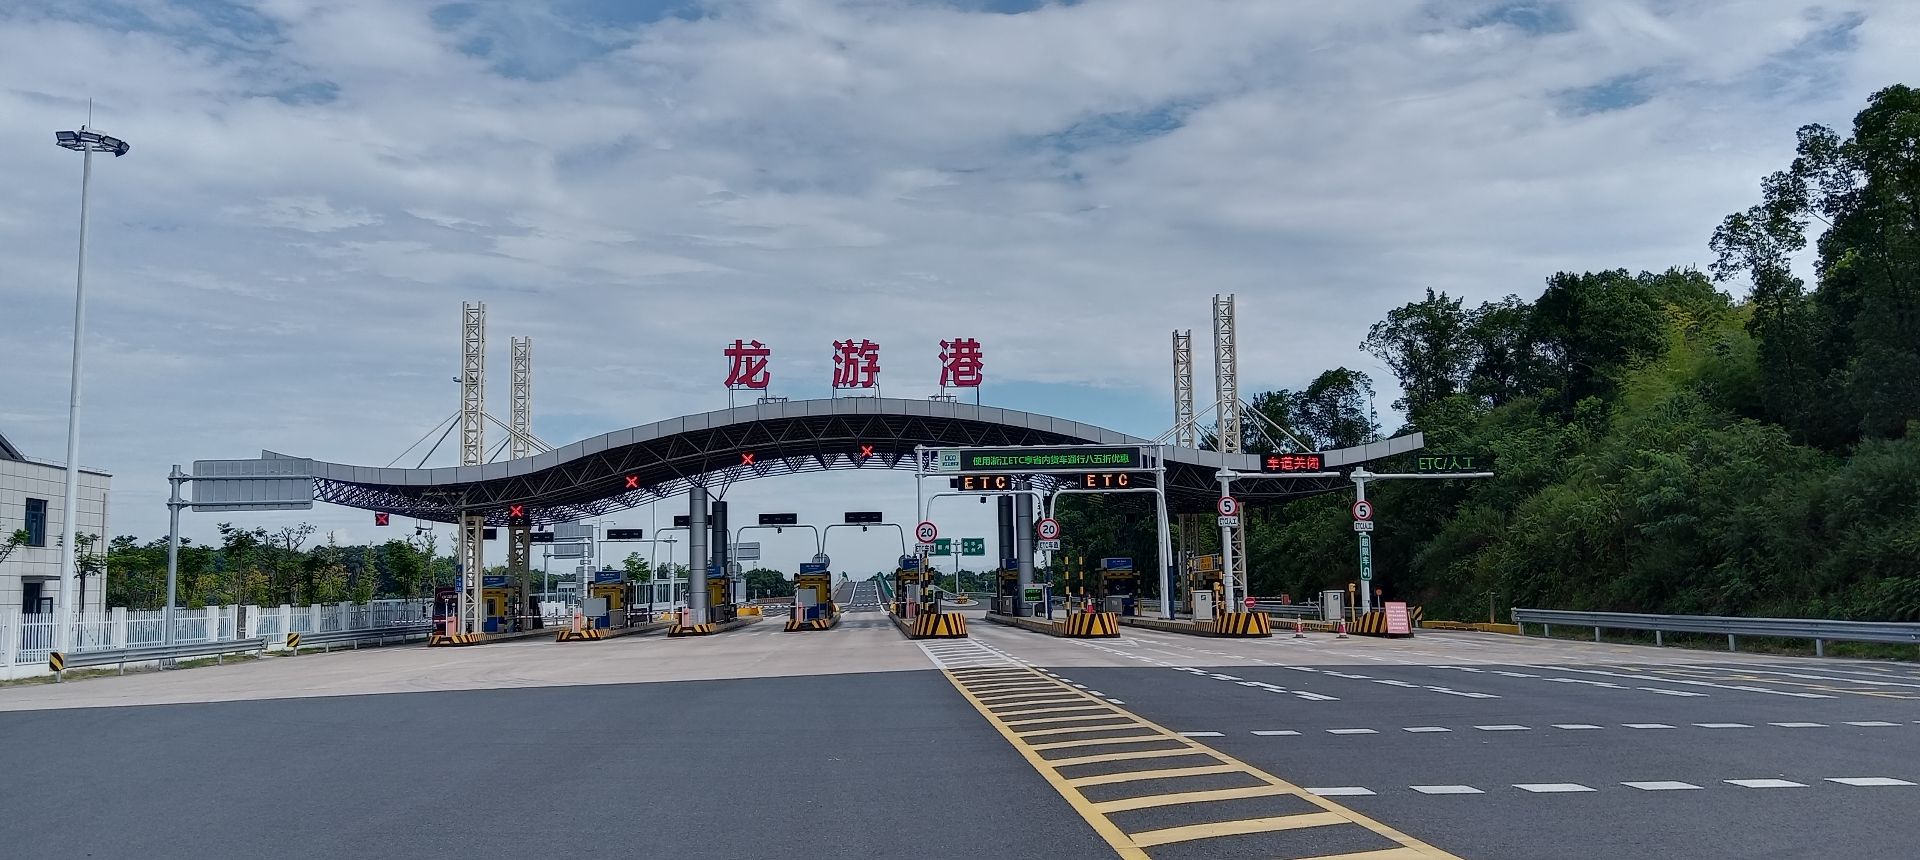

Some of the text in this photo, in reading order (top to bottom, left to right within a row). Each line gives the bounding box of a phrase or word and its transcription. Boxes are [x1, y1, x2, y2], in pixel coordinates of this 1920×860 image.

[724, 338, 984, 388] 龙游港
[1266, 456, 1319, 470] 车道关闭
[1418, 456, 1476, 470] ETC/人工
[964, 476, 1006, 489] ETC
[1087, 473, 1128, 487] ETC
[1223, 500, 1231, 512] 5
[1359, 505, 1367, 517] 5
[920, 527, 933, 537] 20
[1042, 525, 1055, 535] 20
